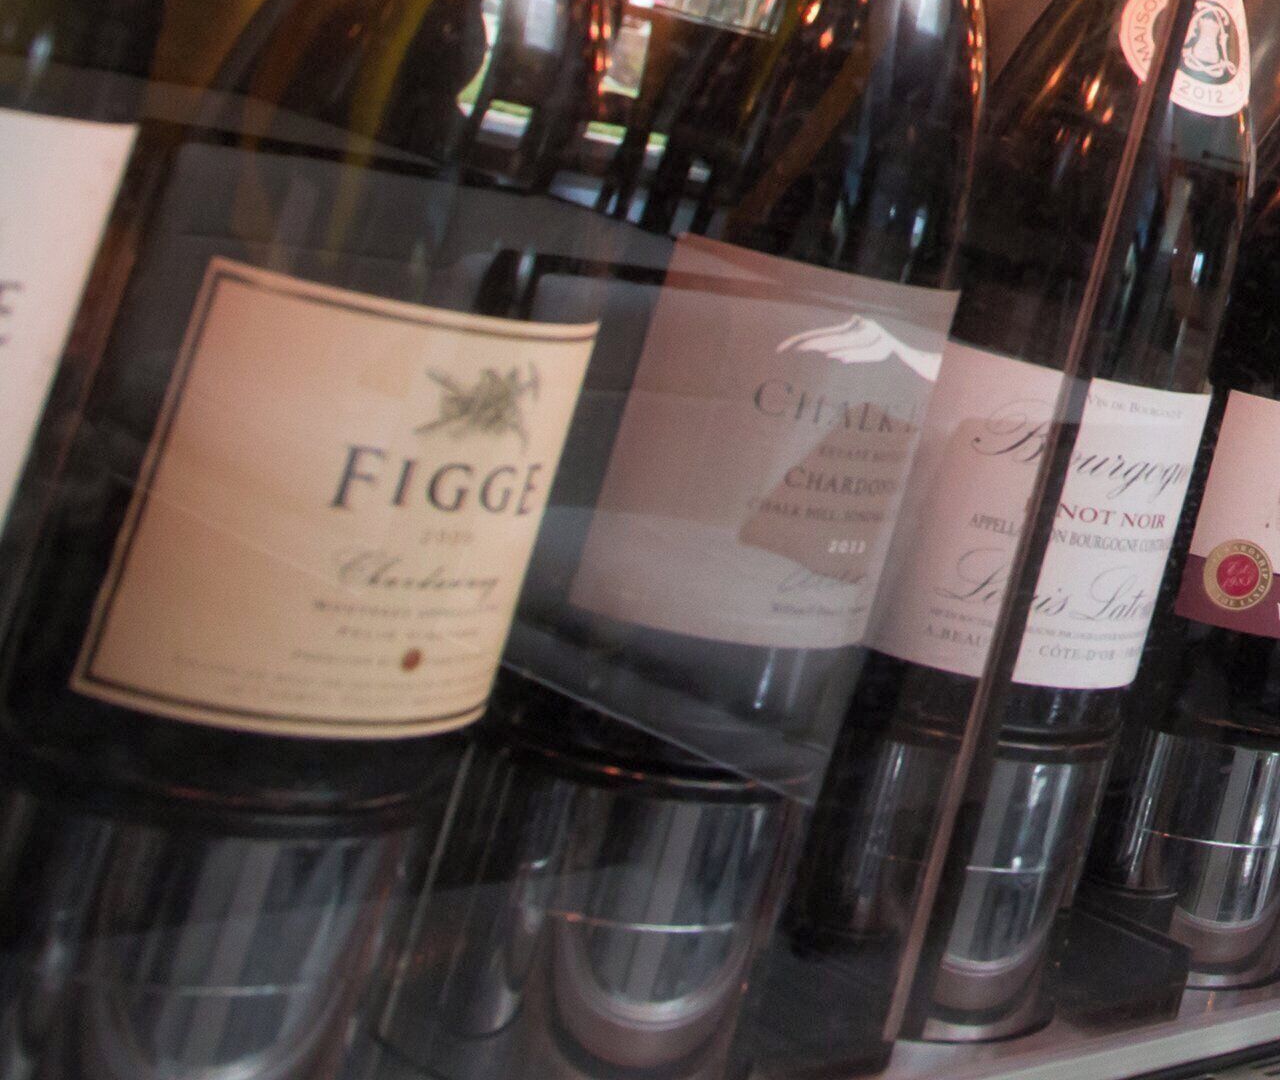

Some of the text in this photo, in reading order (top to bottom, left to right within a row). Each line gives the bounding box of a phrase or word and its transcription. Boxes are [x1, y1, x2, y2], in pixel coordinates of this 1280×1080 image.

[1178, 79, 1225, 104] 2012
[330, 444, 543, 517] FIGGE
[1056, 502, 1167, 530] NOT NOIR
